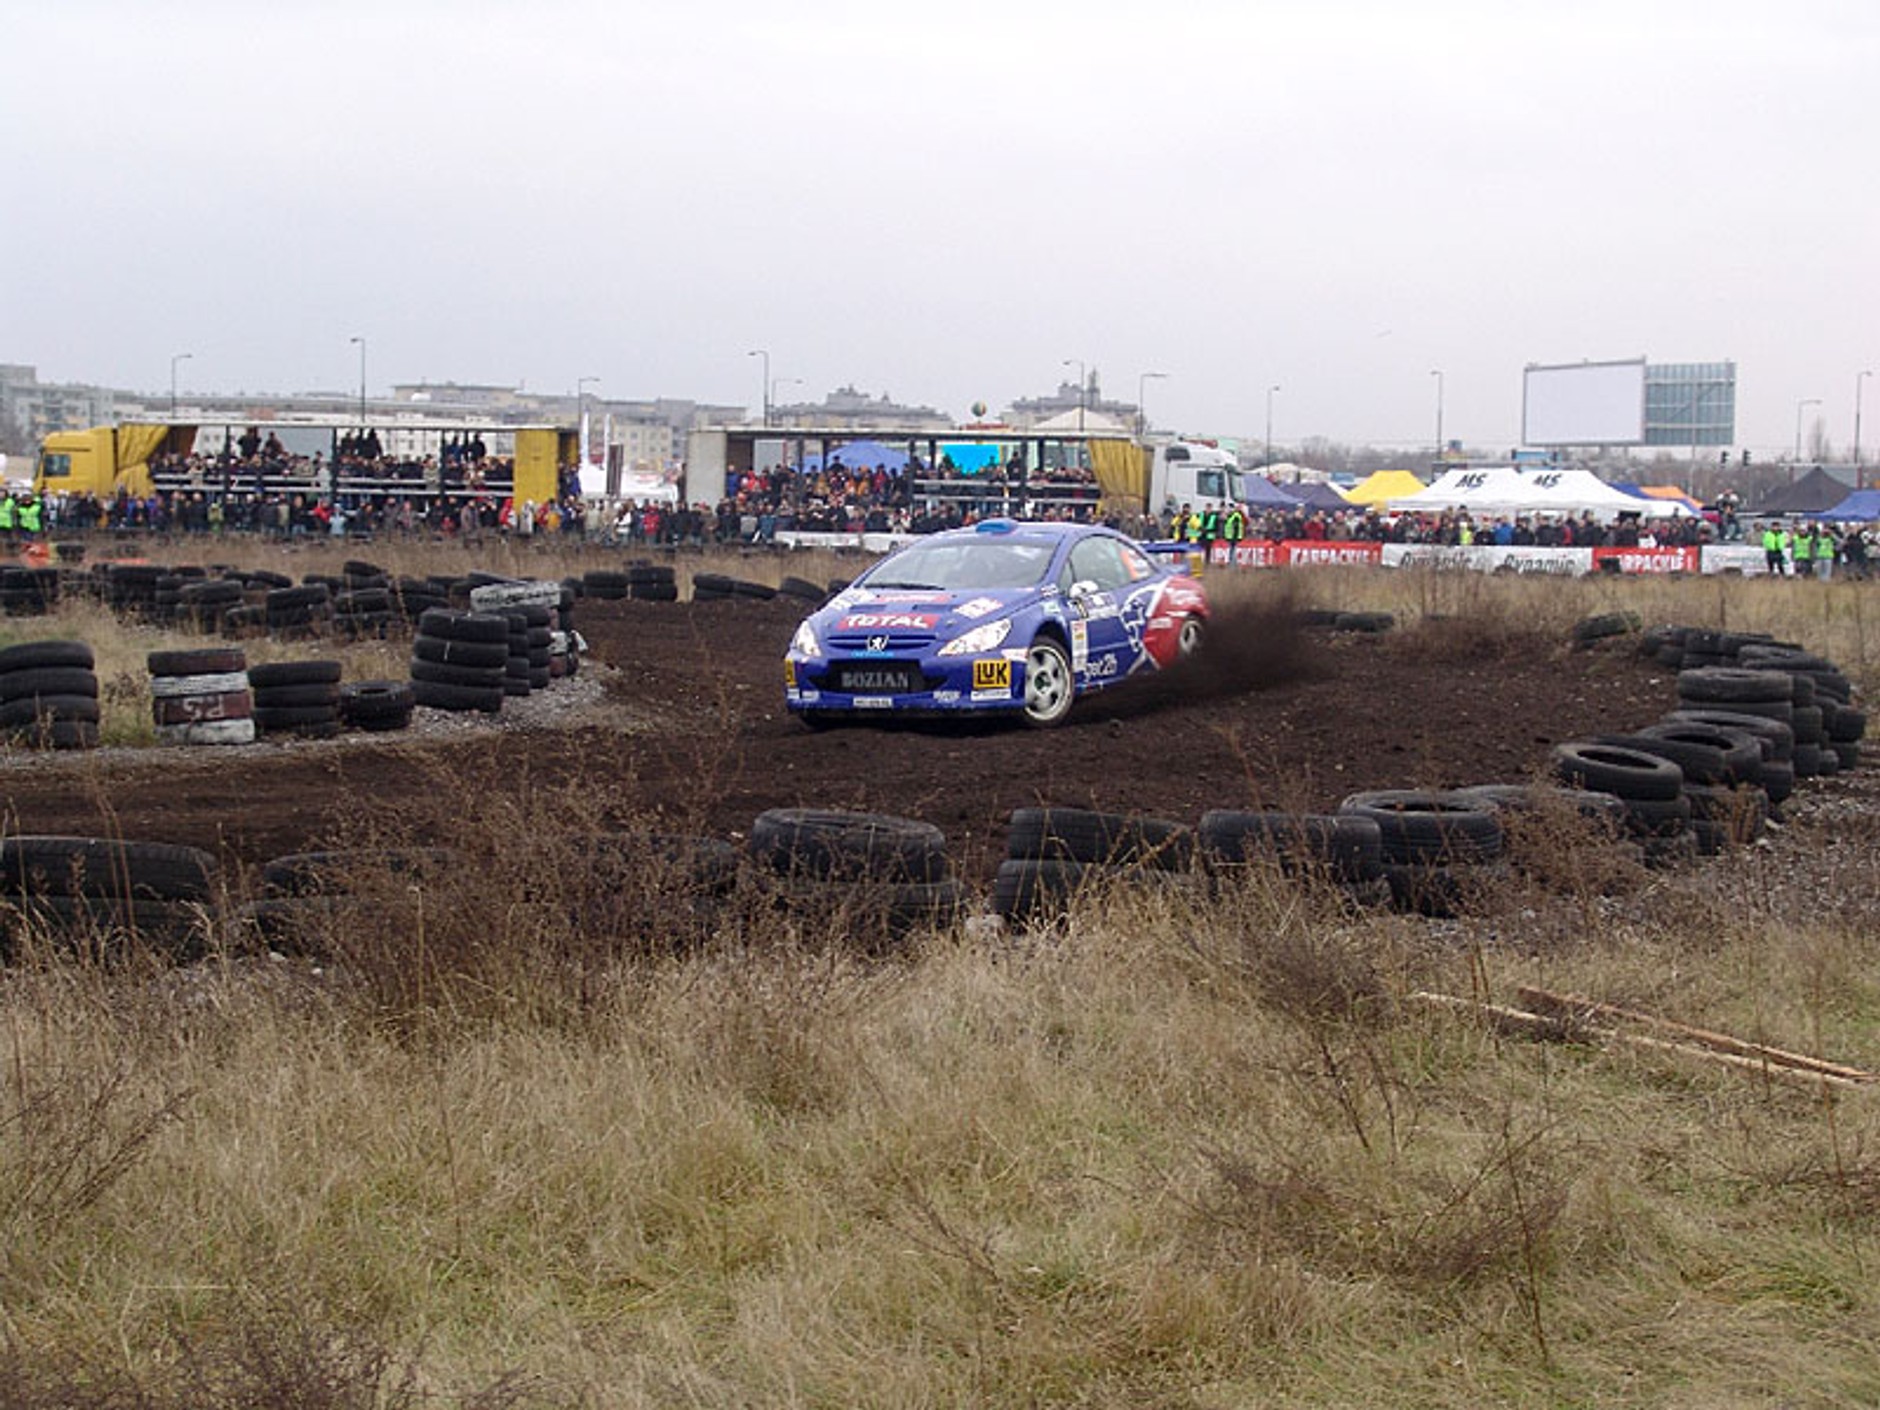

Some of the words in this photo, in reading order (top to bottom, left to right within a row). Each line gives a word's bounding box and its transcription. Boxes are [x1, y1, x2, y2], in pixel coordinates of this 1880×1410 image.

[1455, 473, 1487, 488] MS
[1533, 474, 1562, 488] MS
[847, 614, 929, 628] TOTAL
[841, 672, 909, 688] BOZIAN
